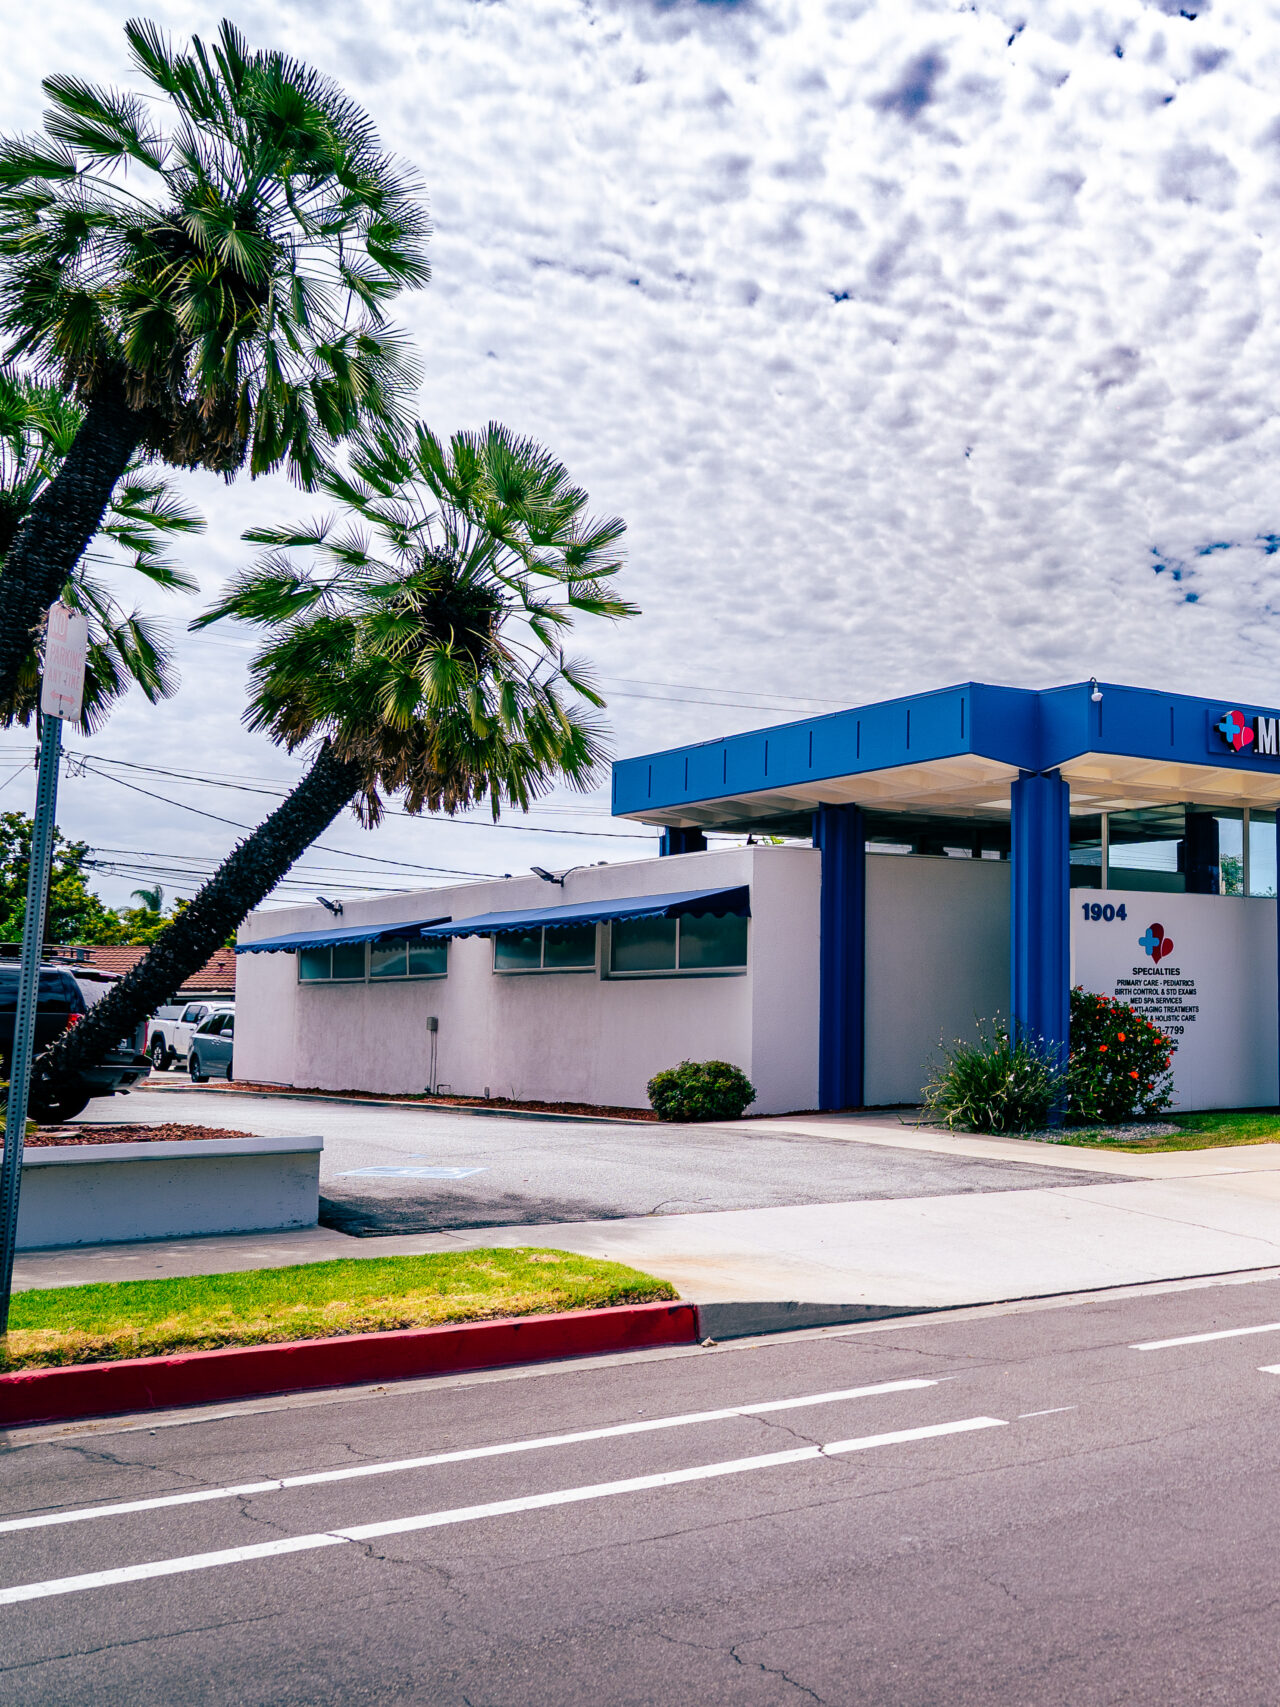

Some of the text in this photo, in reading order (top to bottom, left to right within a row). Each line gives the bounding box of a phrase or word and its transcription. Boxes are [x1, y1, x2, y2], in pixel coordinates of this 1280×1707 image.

[52, 610, 66, 636] NO
[50, 643, 82, 673] PARKING
[48, 667, 80, 691] ANY TIME
[1081, 902, 1127, 922] 1904
[1132, 967, 1180, 976] SPECIALTIES
[1114, 988, 1132, 996] BIRTH
[1133, 988, 1160, 996] CONTROL
[1166, 988, 1177, 996] STD
[1178, 988, 1197, 996] EXAMS
[1116, 979, 1142, 987] PRIMARY
[1143, 979, 1159, 987] CARE
[1163, 979, 1195, 987] PEDIATRICS
